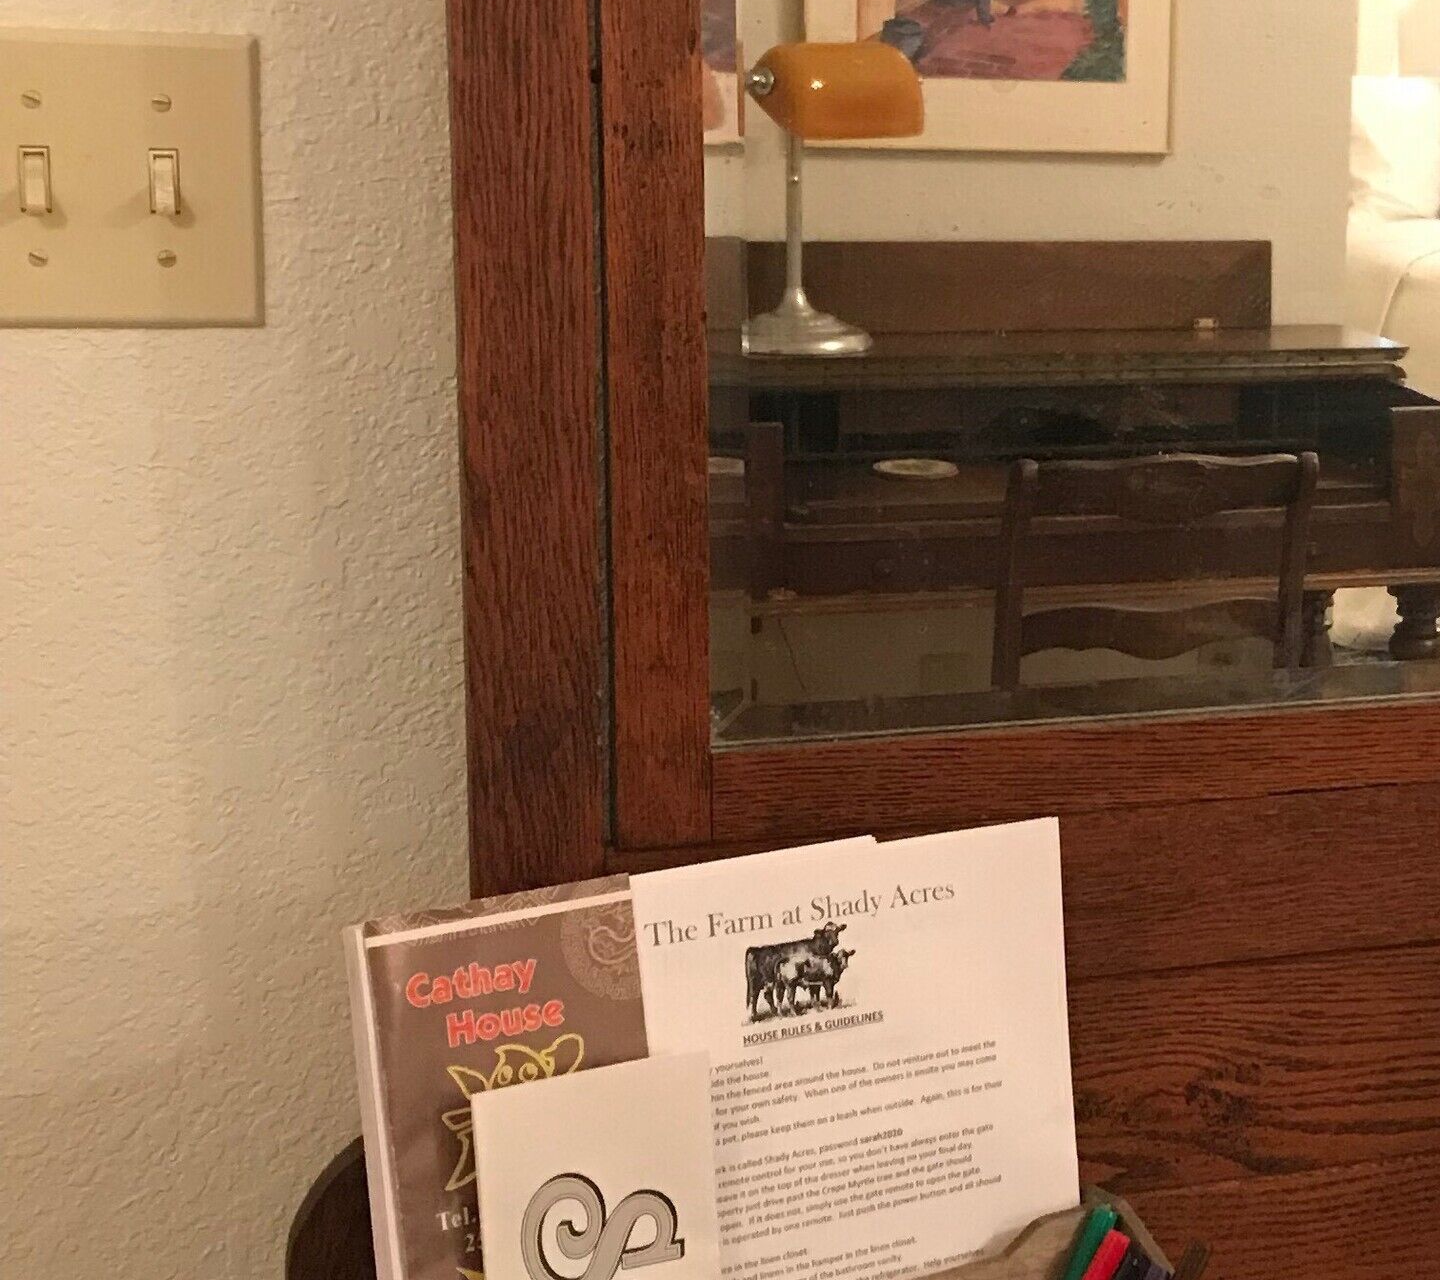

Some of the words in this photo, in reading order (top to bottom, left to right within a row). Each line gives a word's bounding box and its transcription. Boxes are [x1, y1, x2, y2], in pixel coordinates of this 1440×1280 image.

[644, 920, 697, 946] The
[707, 911, 773, 938] Farm
[782, 905, 802, 926] at
[810, 890, 882, 922] Shady
[890, 883, 955, 909] Acres
[405, 958, 537, 1008] Cathay
[446, 1000, 565, 1047] House
[743, 1028, 778, 1046] HOUSE
[781, 1022, 813, 1040] RULES
[814, 1020, 823, 1034] &
[824, 1010, 884, 1032] GUIDELINES
